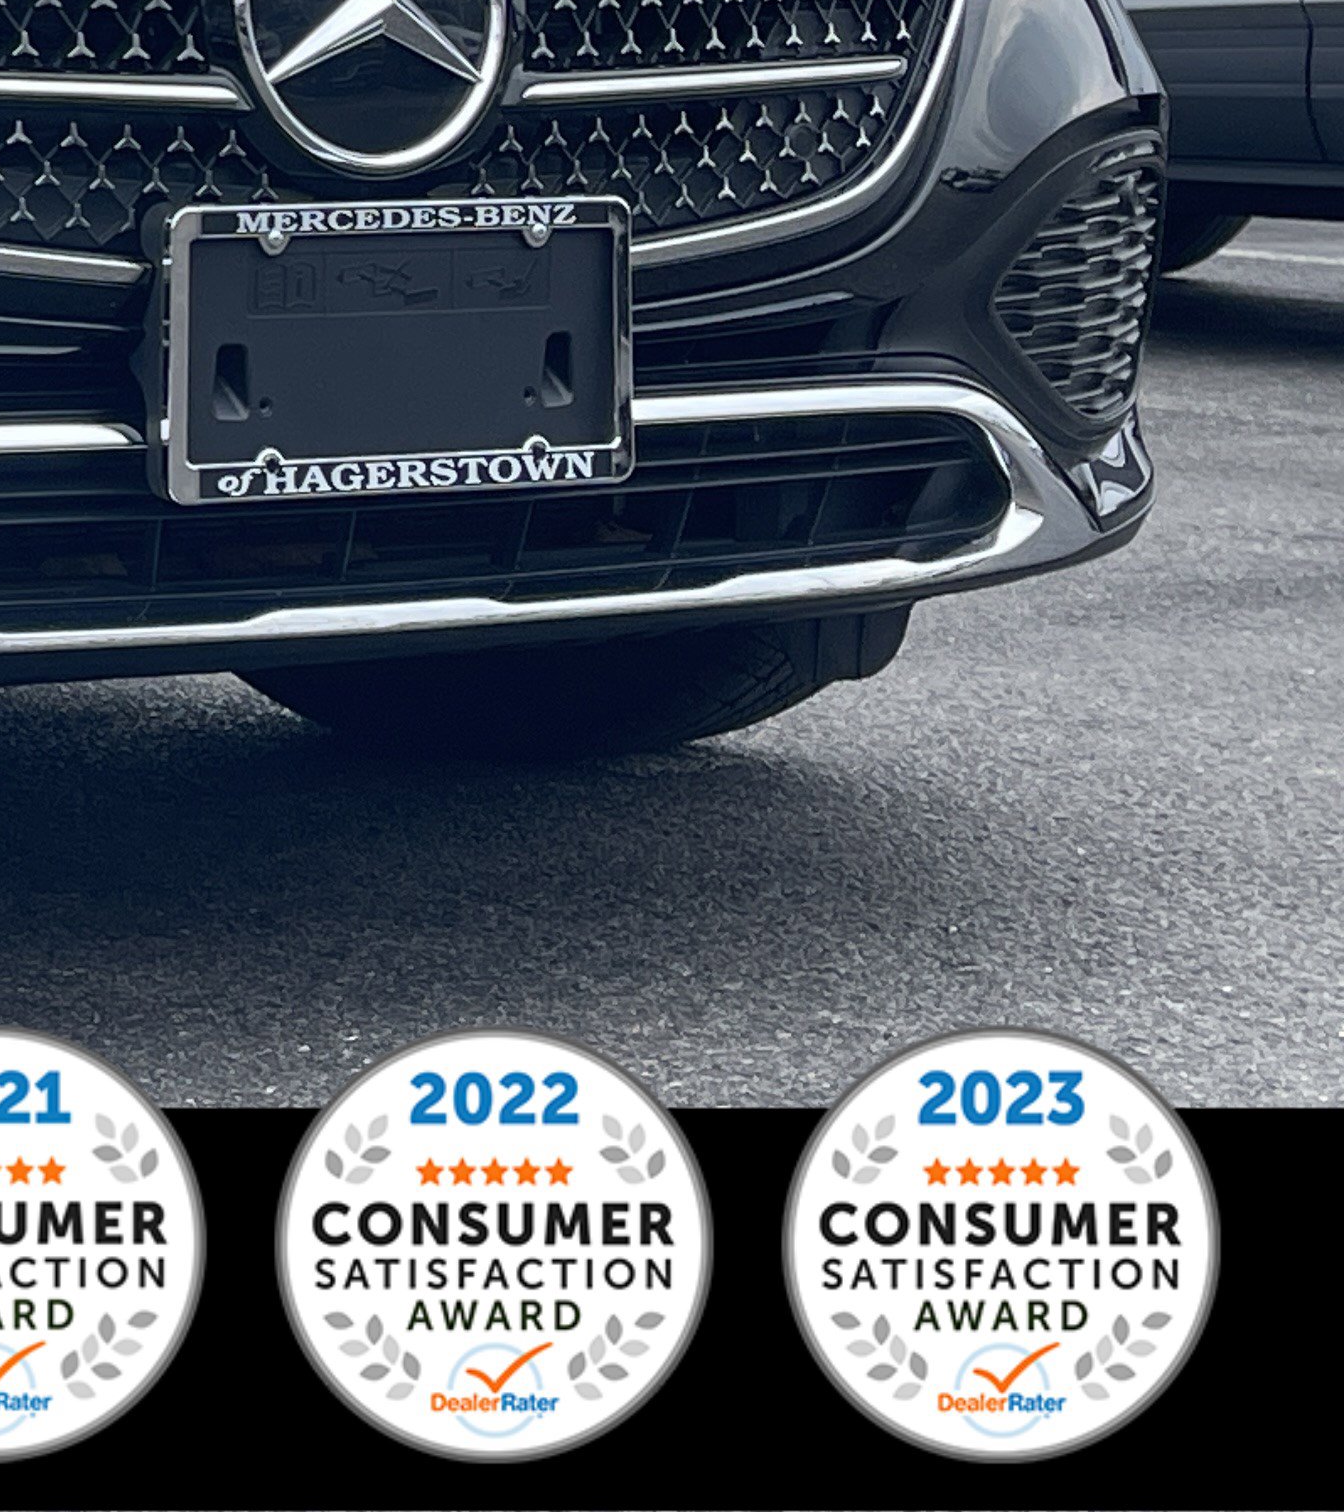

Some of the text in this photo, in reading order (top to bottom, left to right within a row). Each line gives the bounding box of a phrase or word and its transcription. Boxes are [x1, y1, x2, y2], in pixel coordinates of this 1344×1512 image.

[236, 203, 578, 234] MERCEDES-BENZ
[217, 451, 597, 496] of HAGERSTOWN
